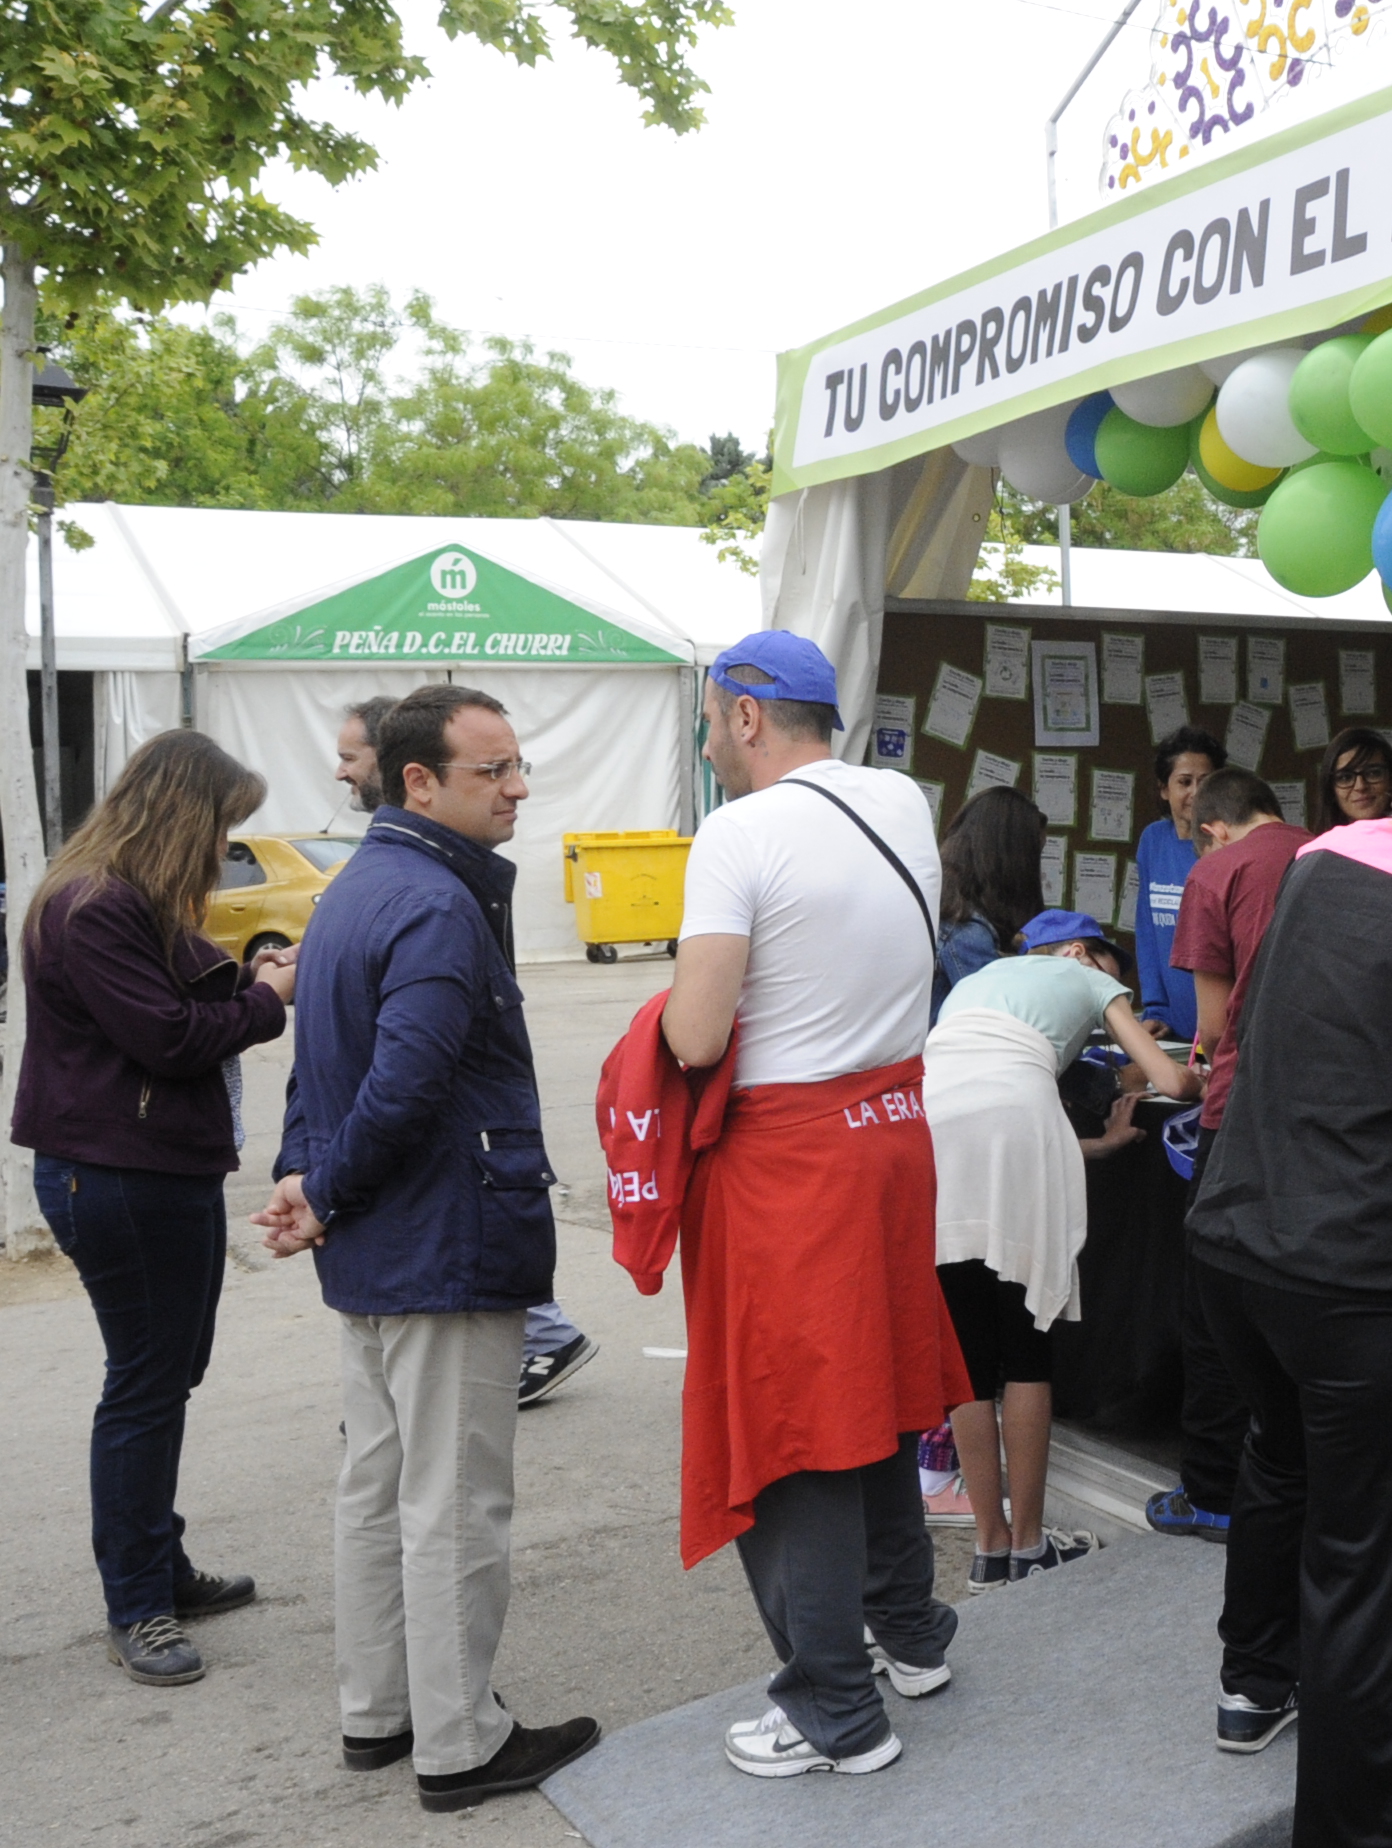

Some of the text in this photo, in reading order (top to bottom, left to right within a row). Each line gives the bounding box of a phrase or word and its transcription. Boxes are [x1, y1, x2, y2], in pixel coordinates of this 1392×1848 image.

[823, 363, 868, 438] TU
[878, 251, 1144, 422] COMPROMISO
[1156, 196, 1271, 316] CON
[1289, 166, 1369, 276] EL
[427, 600, 481, 612] móstoles
[332, 625, 399, 654] PEÑA
[484, 633, 571, 656] CHURRI
[843, 1091, 925, 1128] LA ERA
